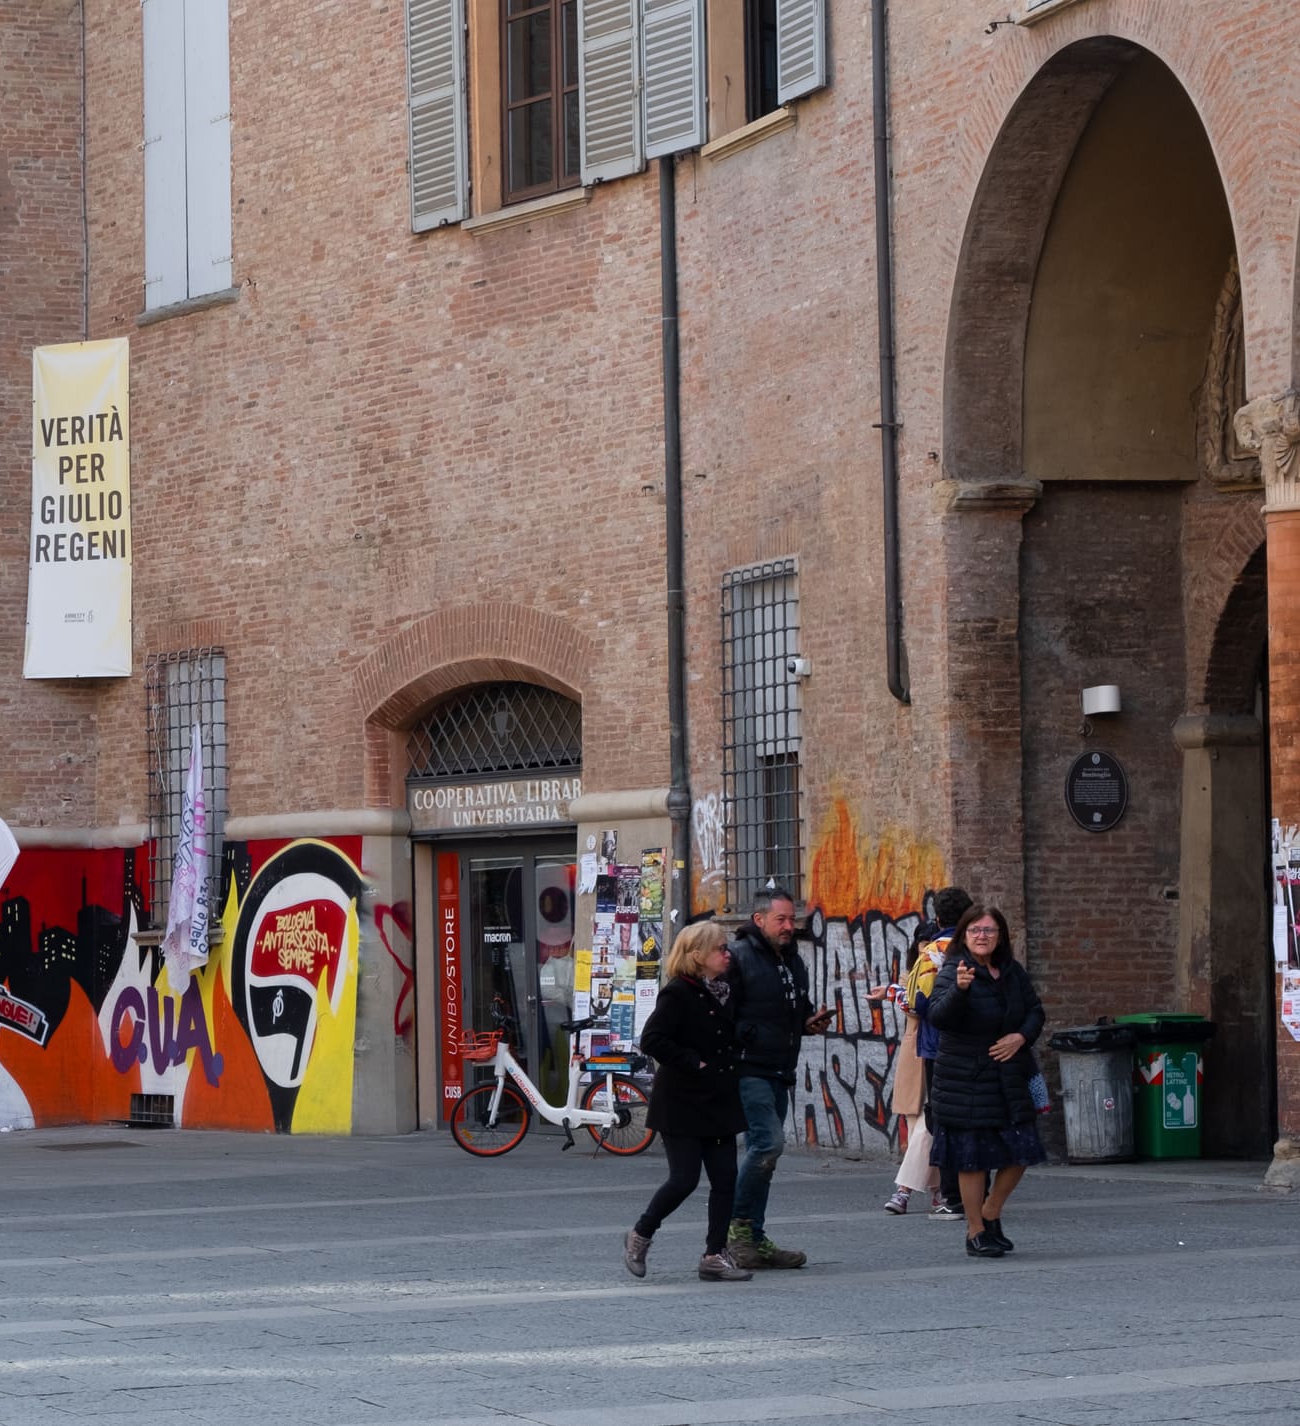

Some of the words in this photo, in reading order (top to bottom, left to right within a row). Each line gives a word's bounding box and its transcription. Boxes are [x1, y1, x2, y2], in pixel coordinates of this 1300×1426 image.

[41, 405, 123, 447] VERITÀ
[59, 453, 105, 485] PER
[40, 490, 122, 524] GIULIO
[35, 529, 126, 563] REGENI
[414, 783, 517, 810] COOPERATIVA
[453, 804, 560, 826] UNIVERSITARIA
[191, 909, 206, 948] dalle
[276, 906, 316, 931] BOLOGNA
[484, 933, 512, 943] macron
[278, 949, 315, 974] SEMPRE
[445, 907, 458, 1055] UNIBO/STORE
[445, 1087, 461, 1098] CUSB
